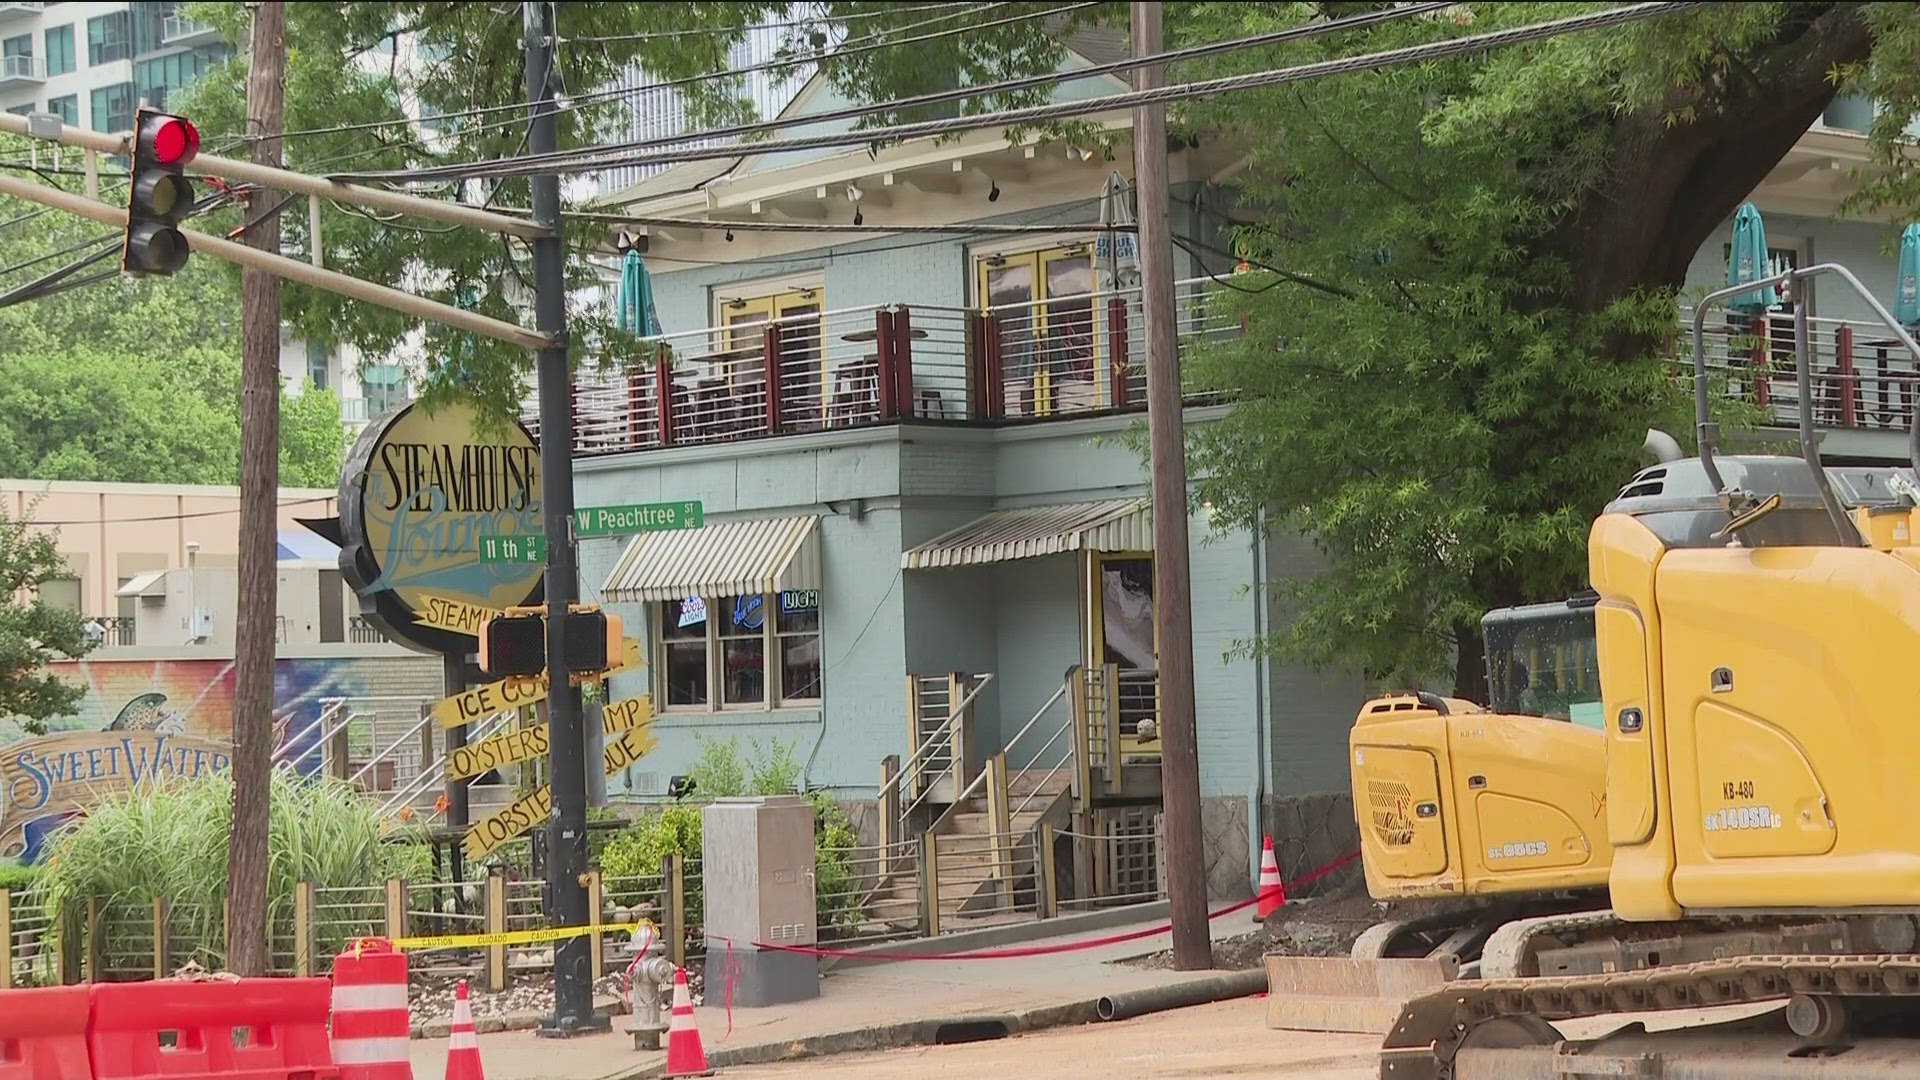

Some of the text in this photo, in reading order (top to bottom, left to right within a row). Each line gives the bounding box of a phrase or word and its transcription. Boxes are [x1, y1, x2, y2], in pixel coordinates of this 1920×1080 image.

[381, 442, 541, 512] STEAMHOUSE
[578, 502, 694, 531] W Peachtree ST
[684, 517, 696, 529] NE
[486, 537, 536, 559] 11 th ST
[526, 550, 537, 561] NE
[684, 610, 704, 623] LIGHT
[456, 688, 496, 720] ICE
[602, 699, 639, 733] IMP
[453, 726, 549, 776] OYSTERS
[1722, 780, 1754, 800] KB-480
[422, 937, 453, 947] CAUTION
[477, 934, 508, 945] CUIDADO
[531, 930, 560, 941] CAUTION
